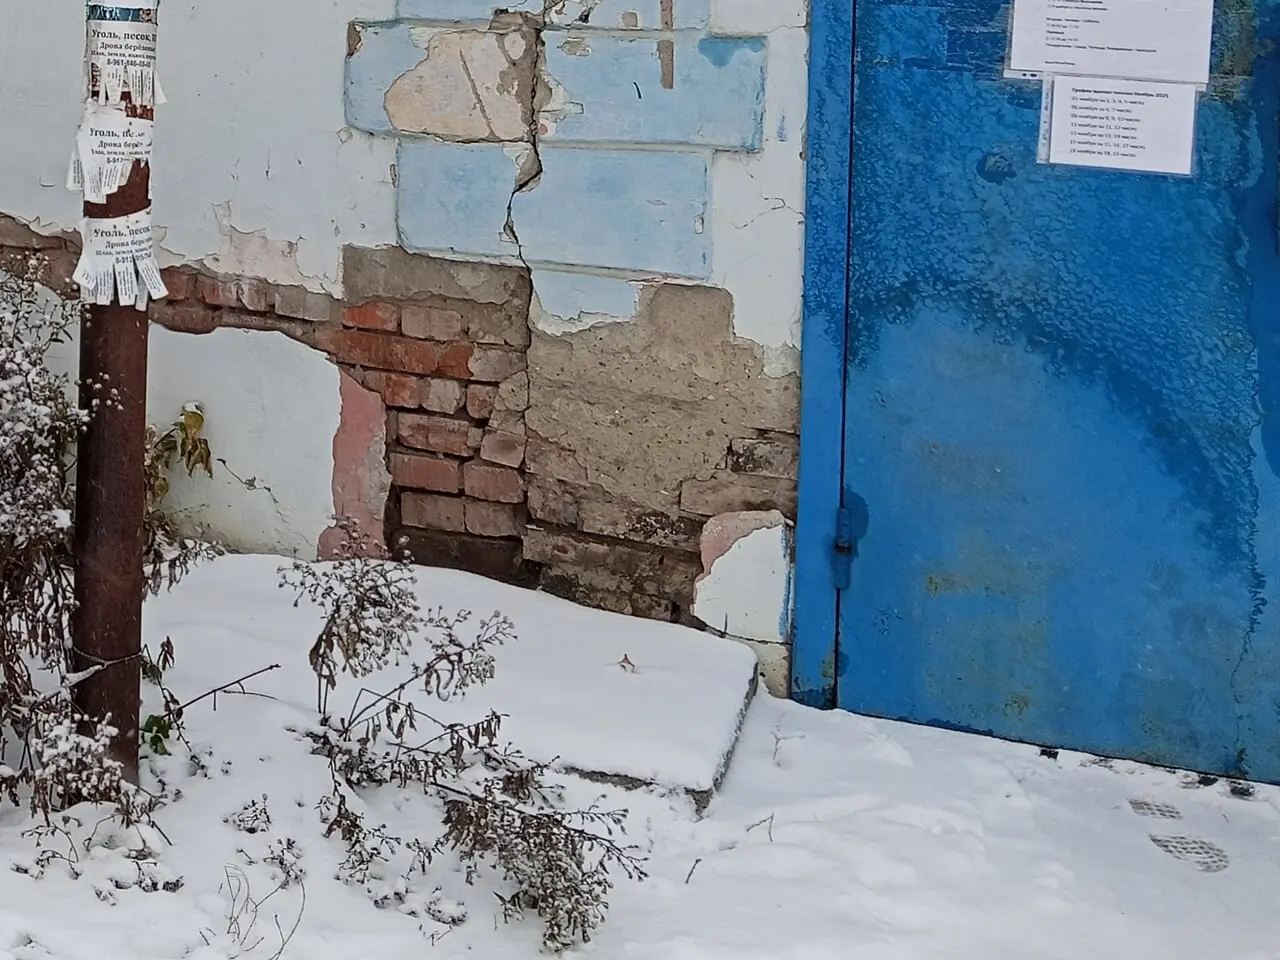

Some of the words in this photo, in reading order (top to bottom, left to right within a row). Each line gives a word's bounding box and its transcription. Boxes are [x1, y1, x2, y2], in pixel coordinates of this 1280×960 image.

[91, 29, 120, 39] Уголь,
[90, 128, 120, 138] Уголь,
[94, 229, 126, 237] Уголь,
[105, 241, 129, 249] Дрова
